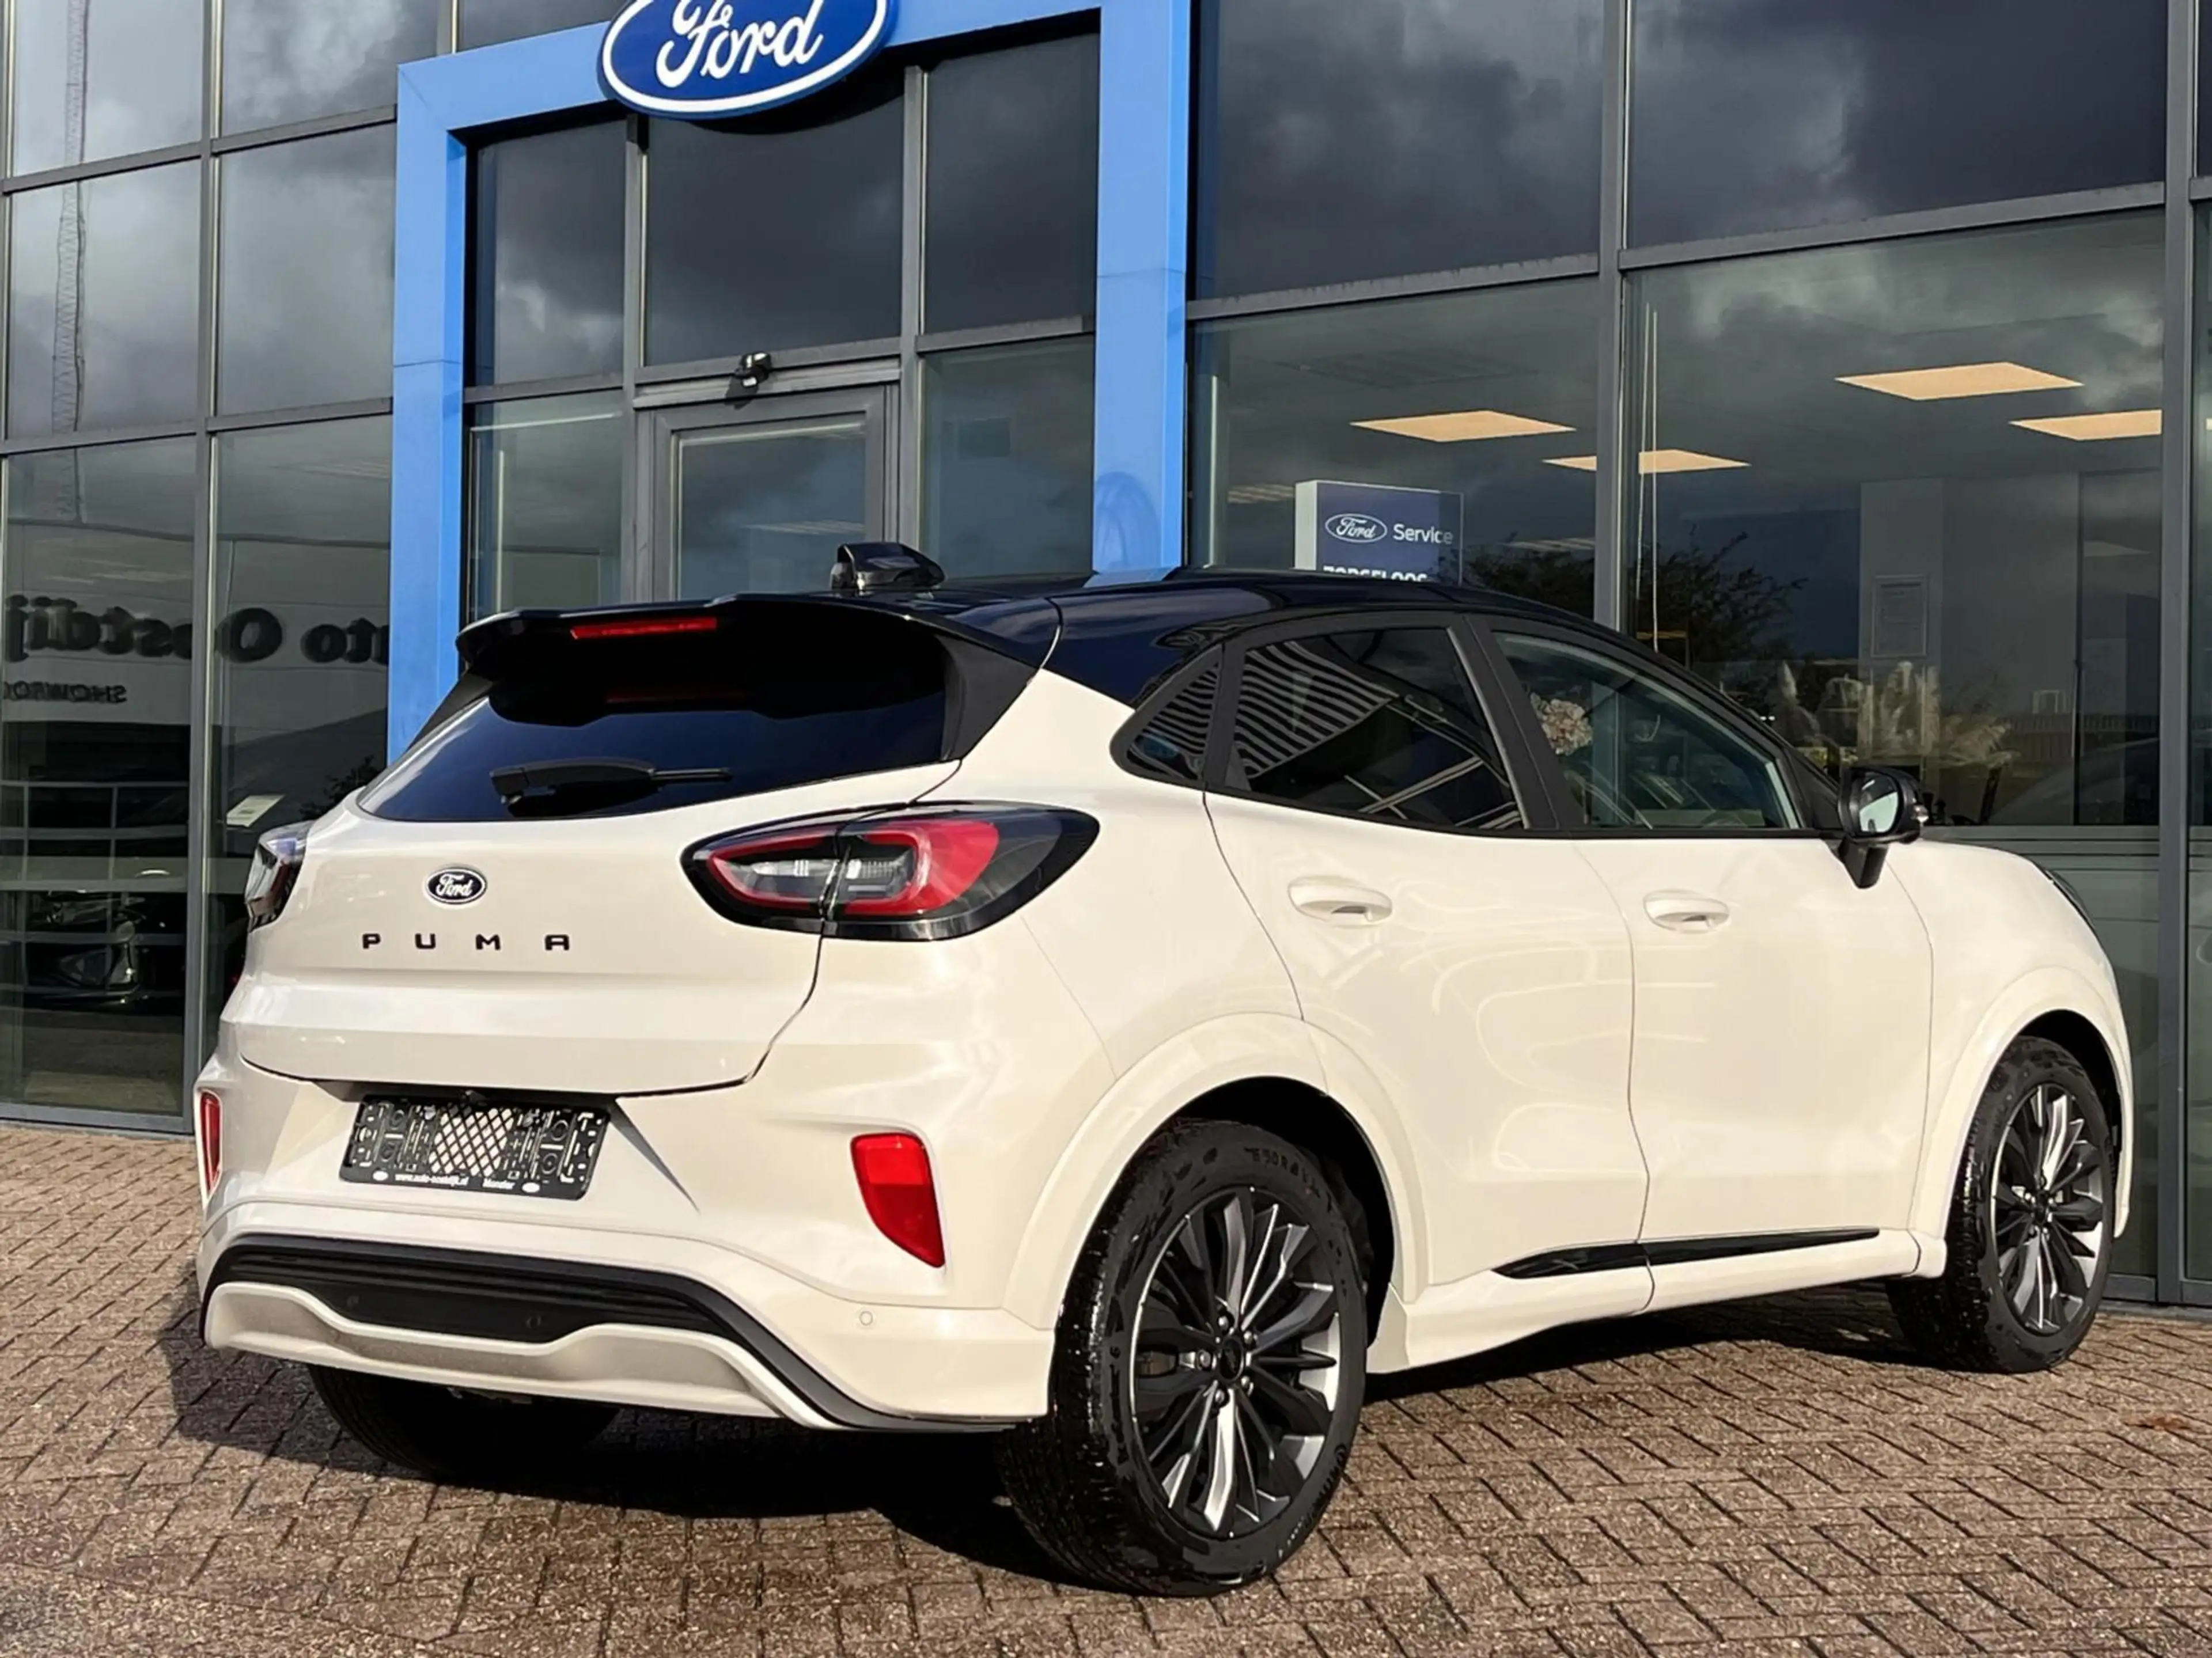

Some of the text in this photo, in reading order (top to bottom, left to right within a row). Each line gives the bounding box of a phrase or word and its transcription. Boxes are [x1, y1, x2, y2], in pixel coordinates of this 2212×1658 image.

[656, 0, 824, 89] Ford
[1336, 516, 1453, 545] Ford Service
[436, 873, 474, 897] Ford
[362, 933, 570, 951] PUMA
